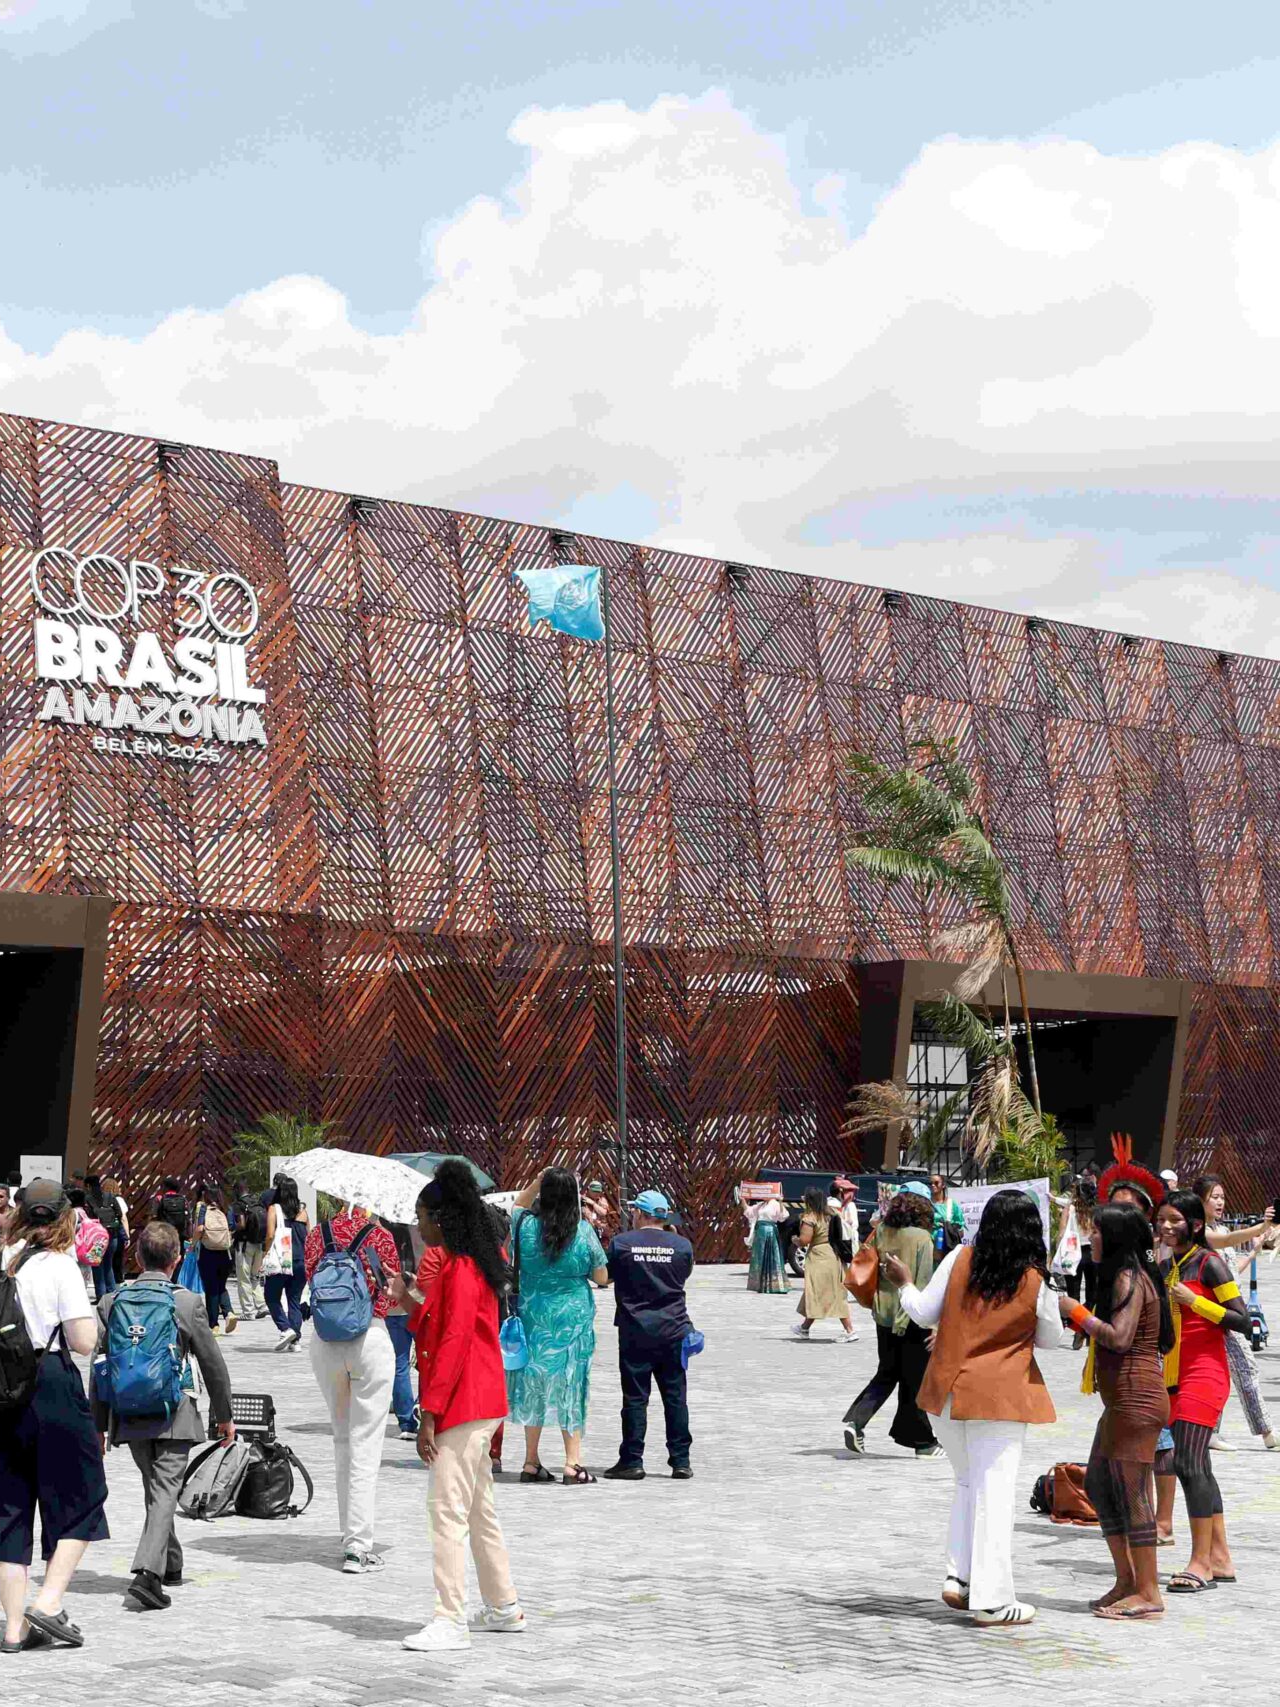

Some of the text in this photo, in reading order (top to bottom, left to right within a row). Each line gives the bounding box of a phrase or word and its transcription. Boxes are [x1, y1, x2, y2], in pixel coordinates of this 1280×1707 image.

[34, 617, 267, 705] BRASIL
[39, 686, 269, 745] AMAZÔNIA
[92, 735, 221, 763] BELÉM 2025
[631, 1245, 675, 1255] MINISTÉRIO
[633, 1254, 673, 1263] DA SAÚDE
